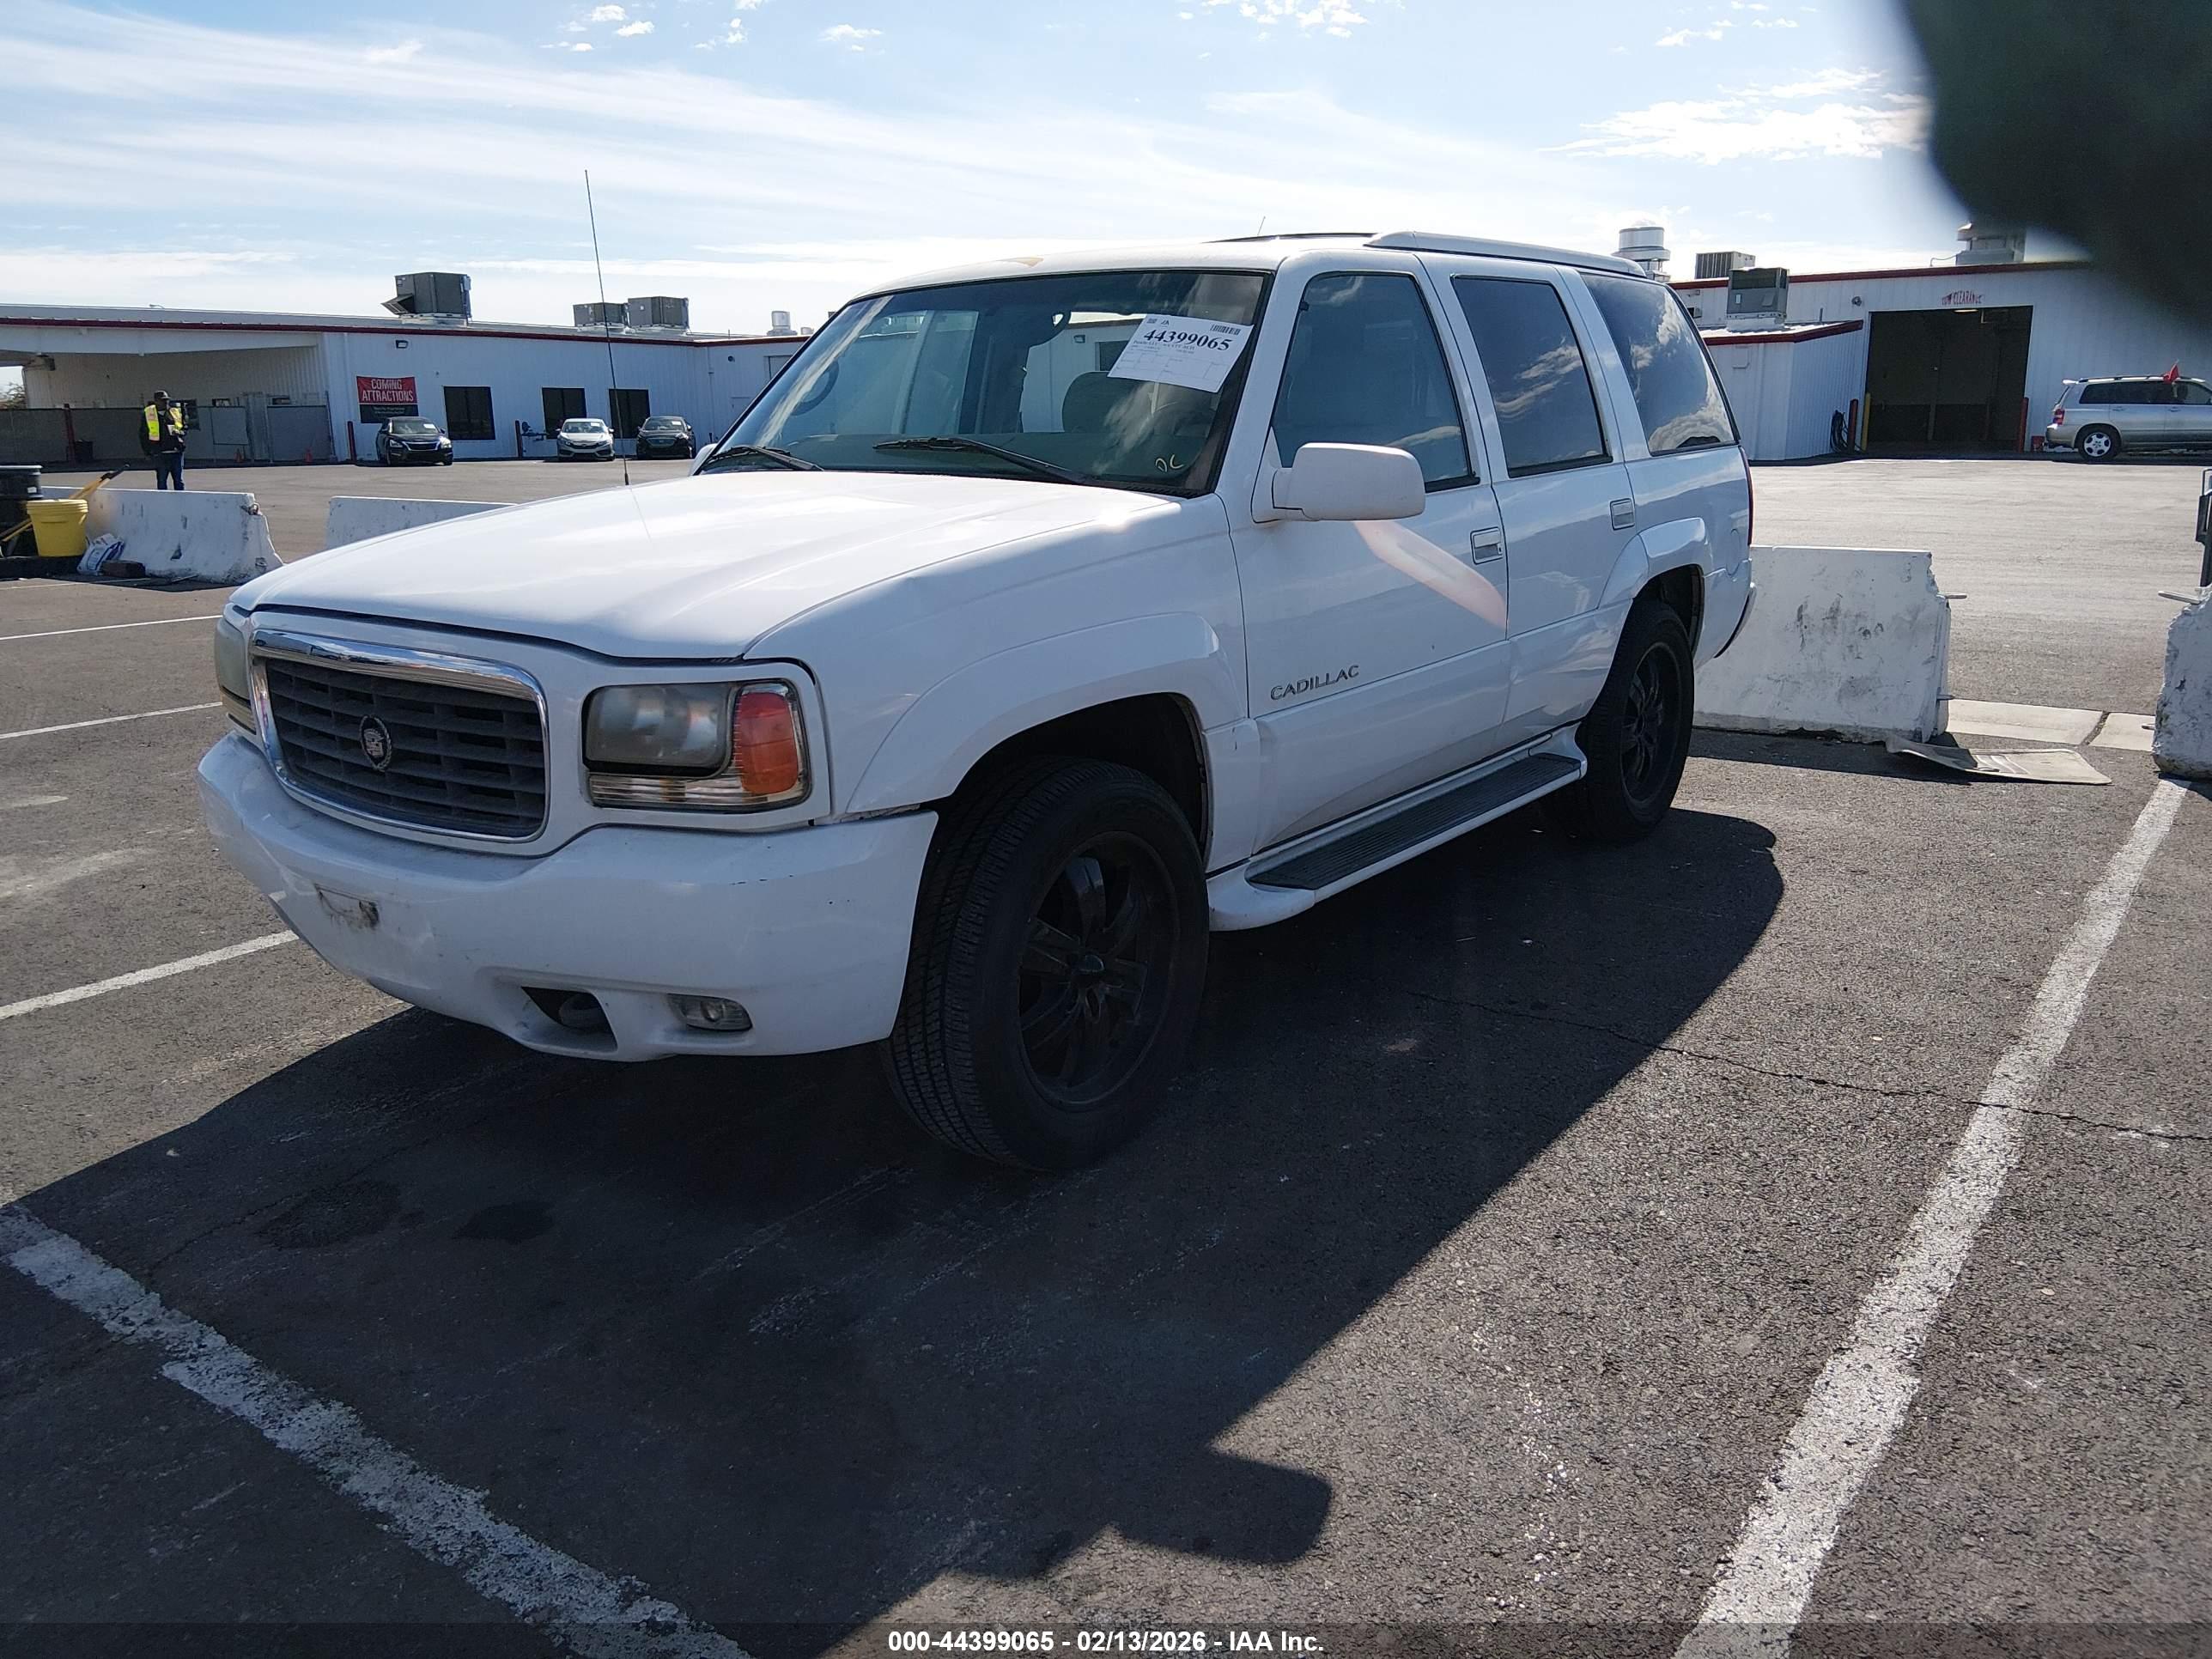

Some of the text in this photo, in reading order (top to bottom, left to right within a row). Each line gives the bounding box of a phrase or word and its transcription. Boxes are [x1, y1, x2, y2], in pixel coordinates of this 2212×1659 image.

[1144, 329, 1233, 351] 44399065
[371, 379, 403, 390] COMING
[362, 390, 414, 402] ATTRACTIONS
[1270, 665, 1359, 700] CADILLAC
